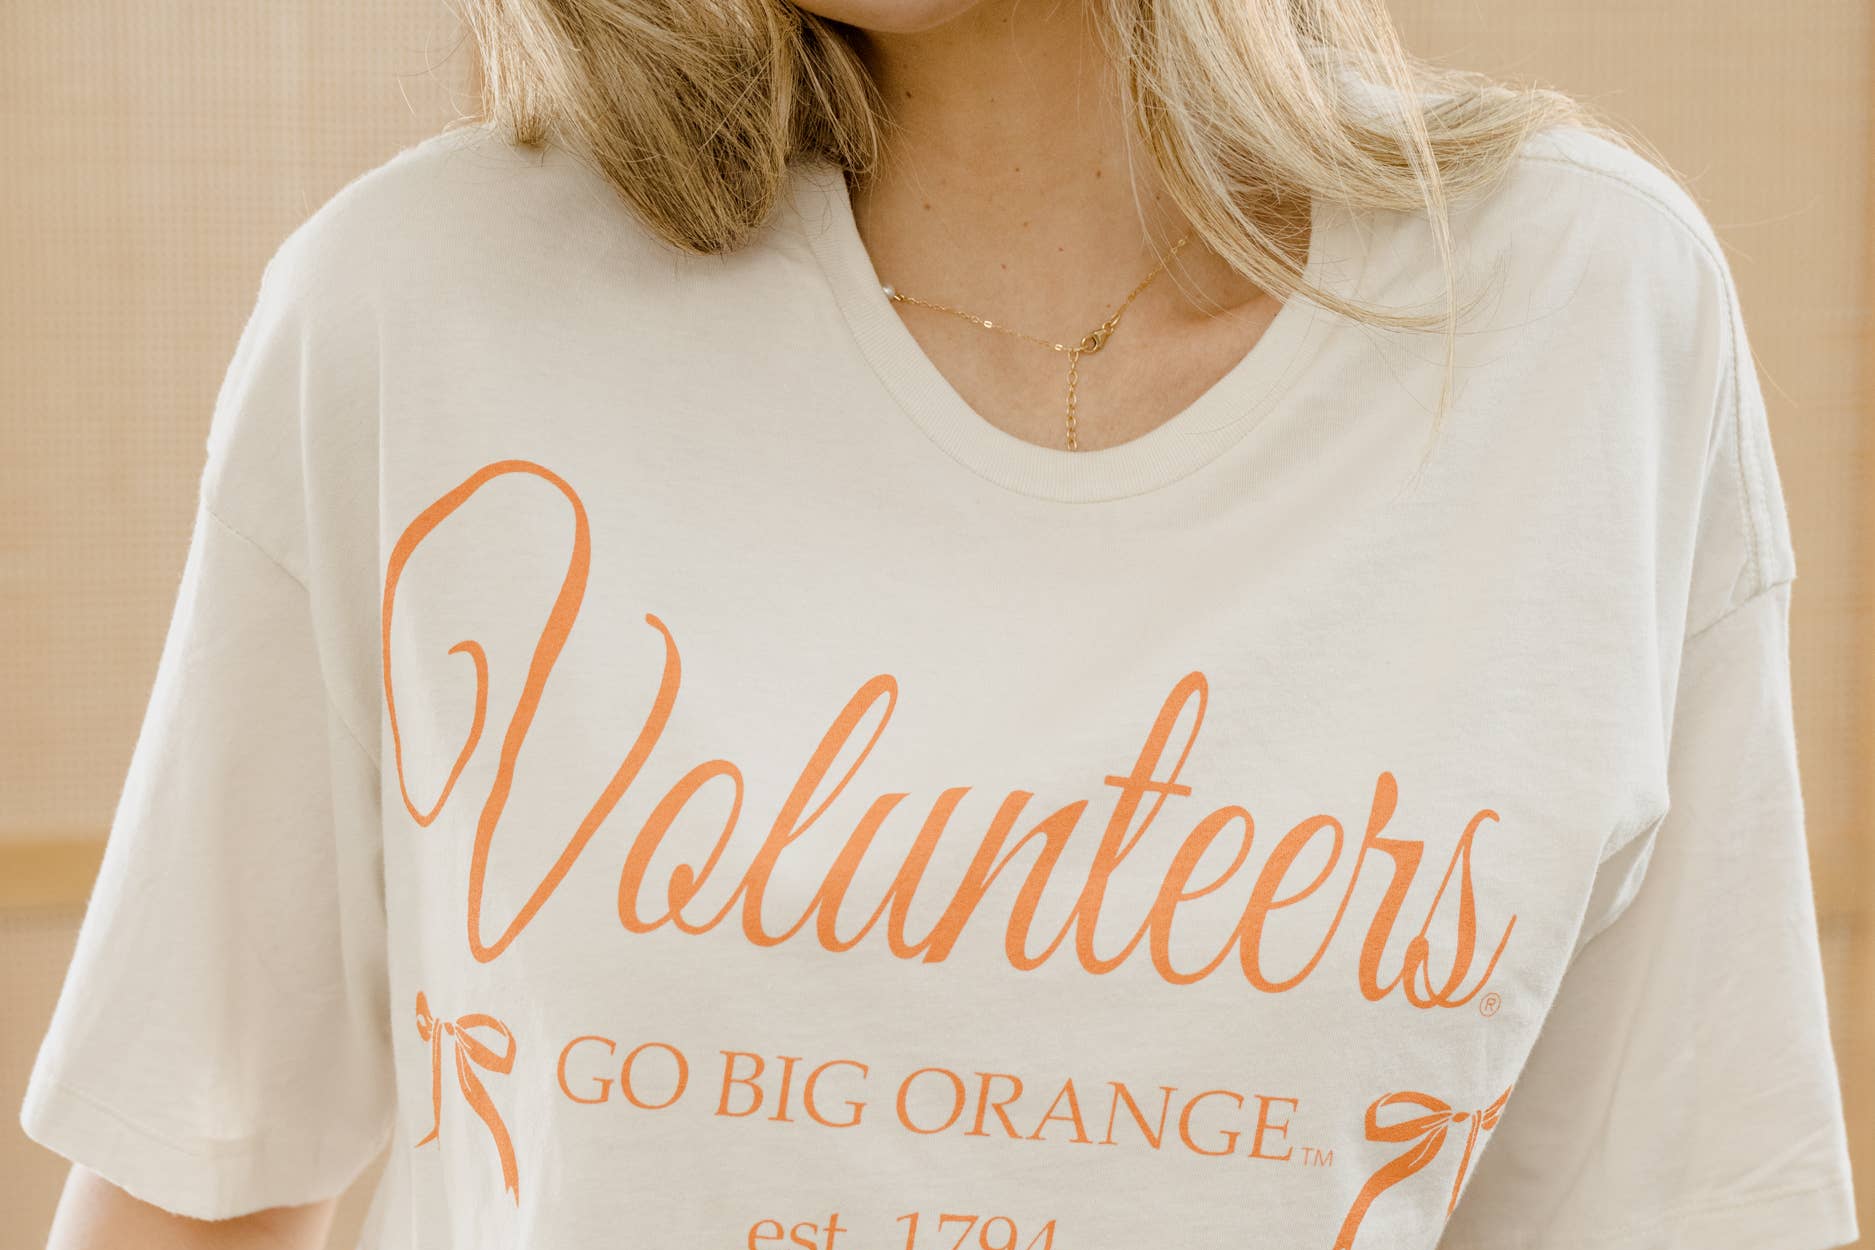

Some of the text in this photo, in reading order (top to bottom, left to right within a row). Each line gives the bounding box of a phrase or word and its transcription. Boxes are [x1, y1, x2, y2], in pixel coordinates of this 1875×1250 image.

[383, 460, 1517, 1010] Volunteers
[557, 1036, 688, 1111] GO
[717, 1051, 868, 1128] BIG
[896, 1067, 1300, 1162] ORANGE
